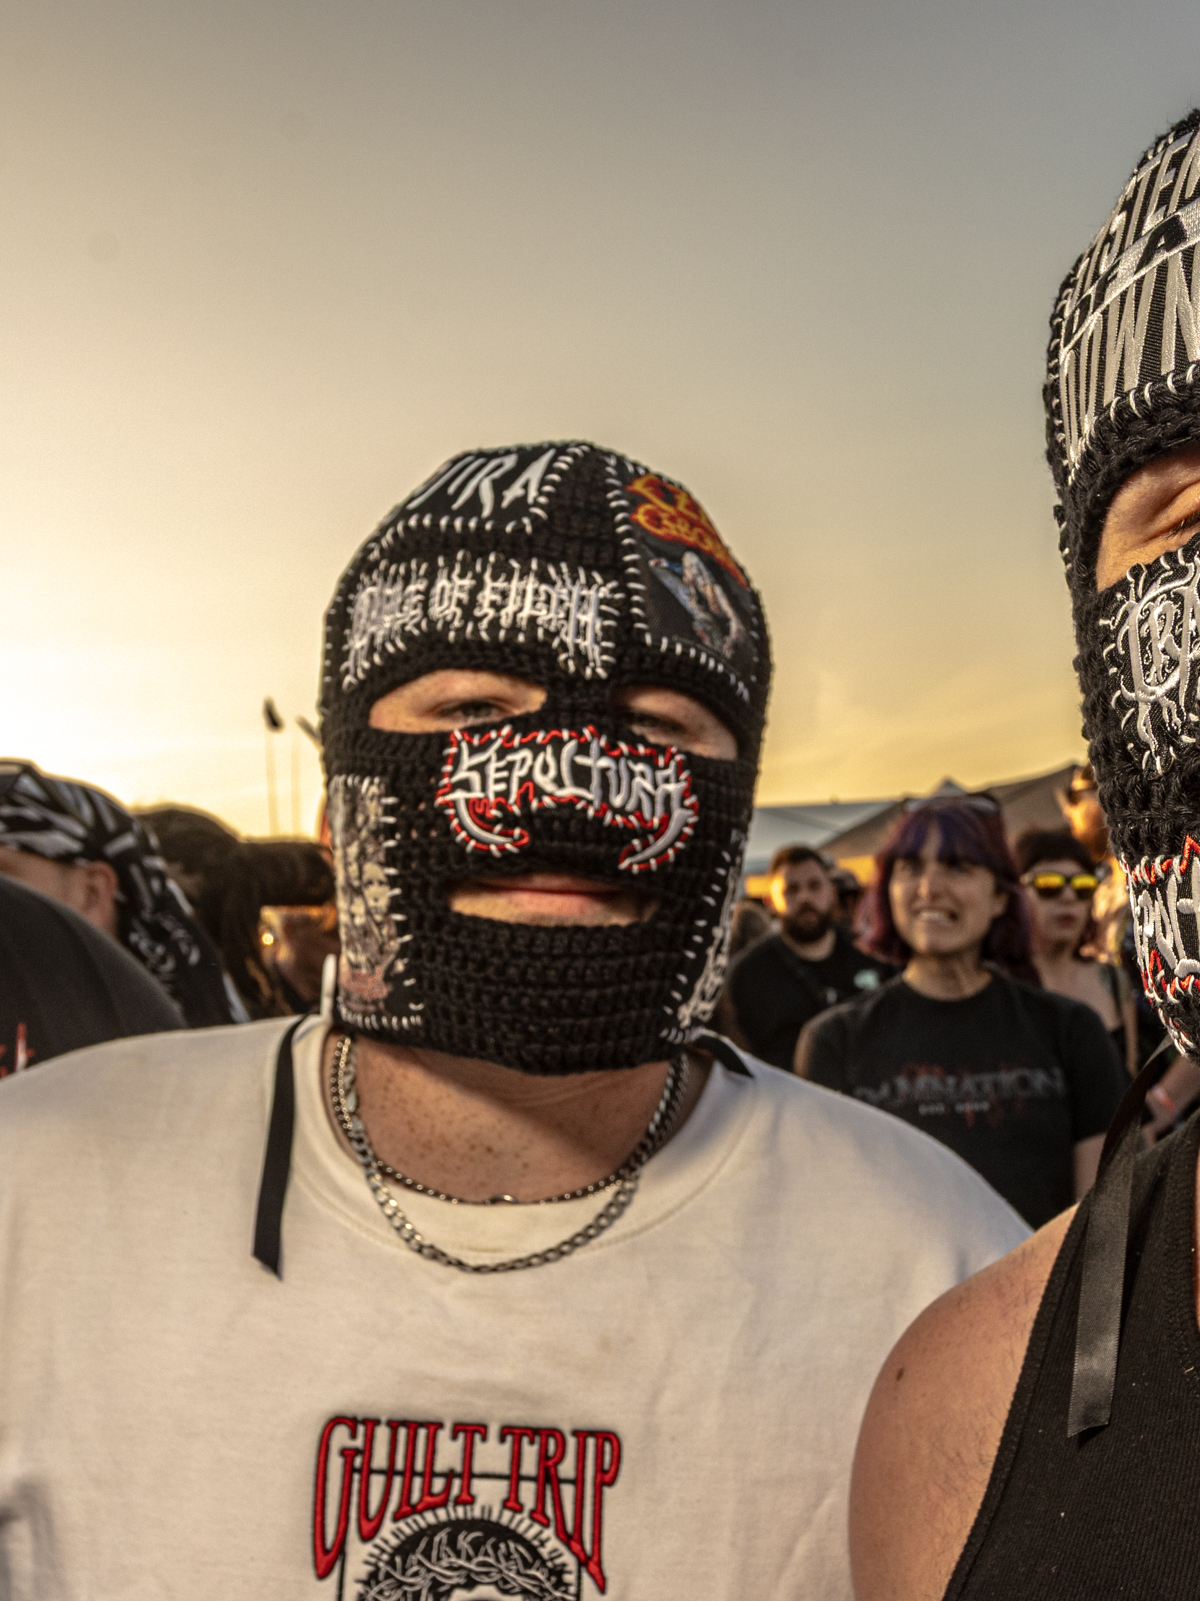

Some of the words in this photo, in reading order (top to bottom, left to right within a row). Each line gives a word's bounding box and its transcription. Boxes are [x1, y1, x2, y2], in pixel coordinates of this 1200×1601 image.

[405, 449, 556, 520] JIRA
[313, 1415, 488, 1581] GUILT
[499, 1425, 623, 1595] TRIP
